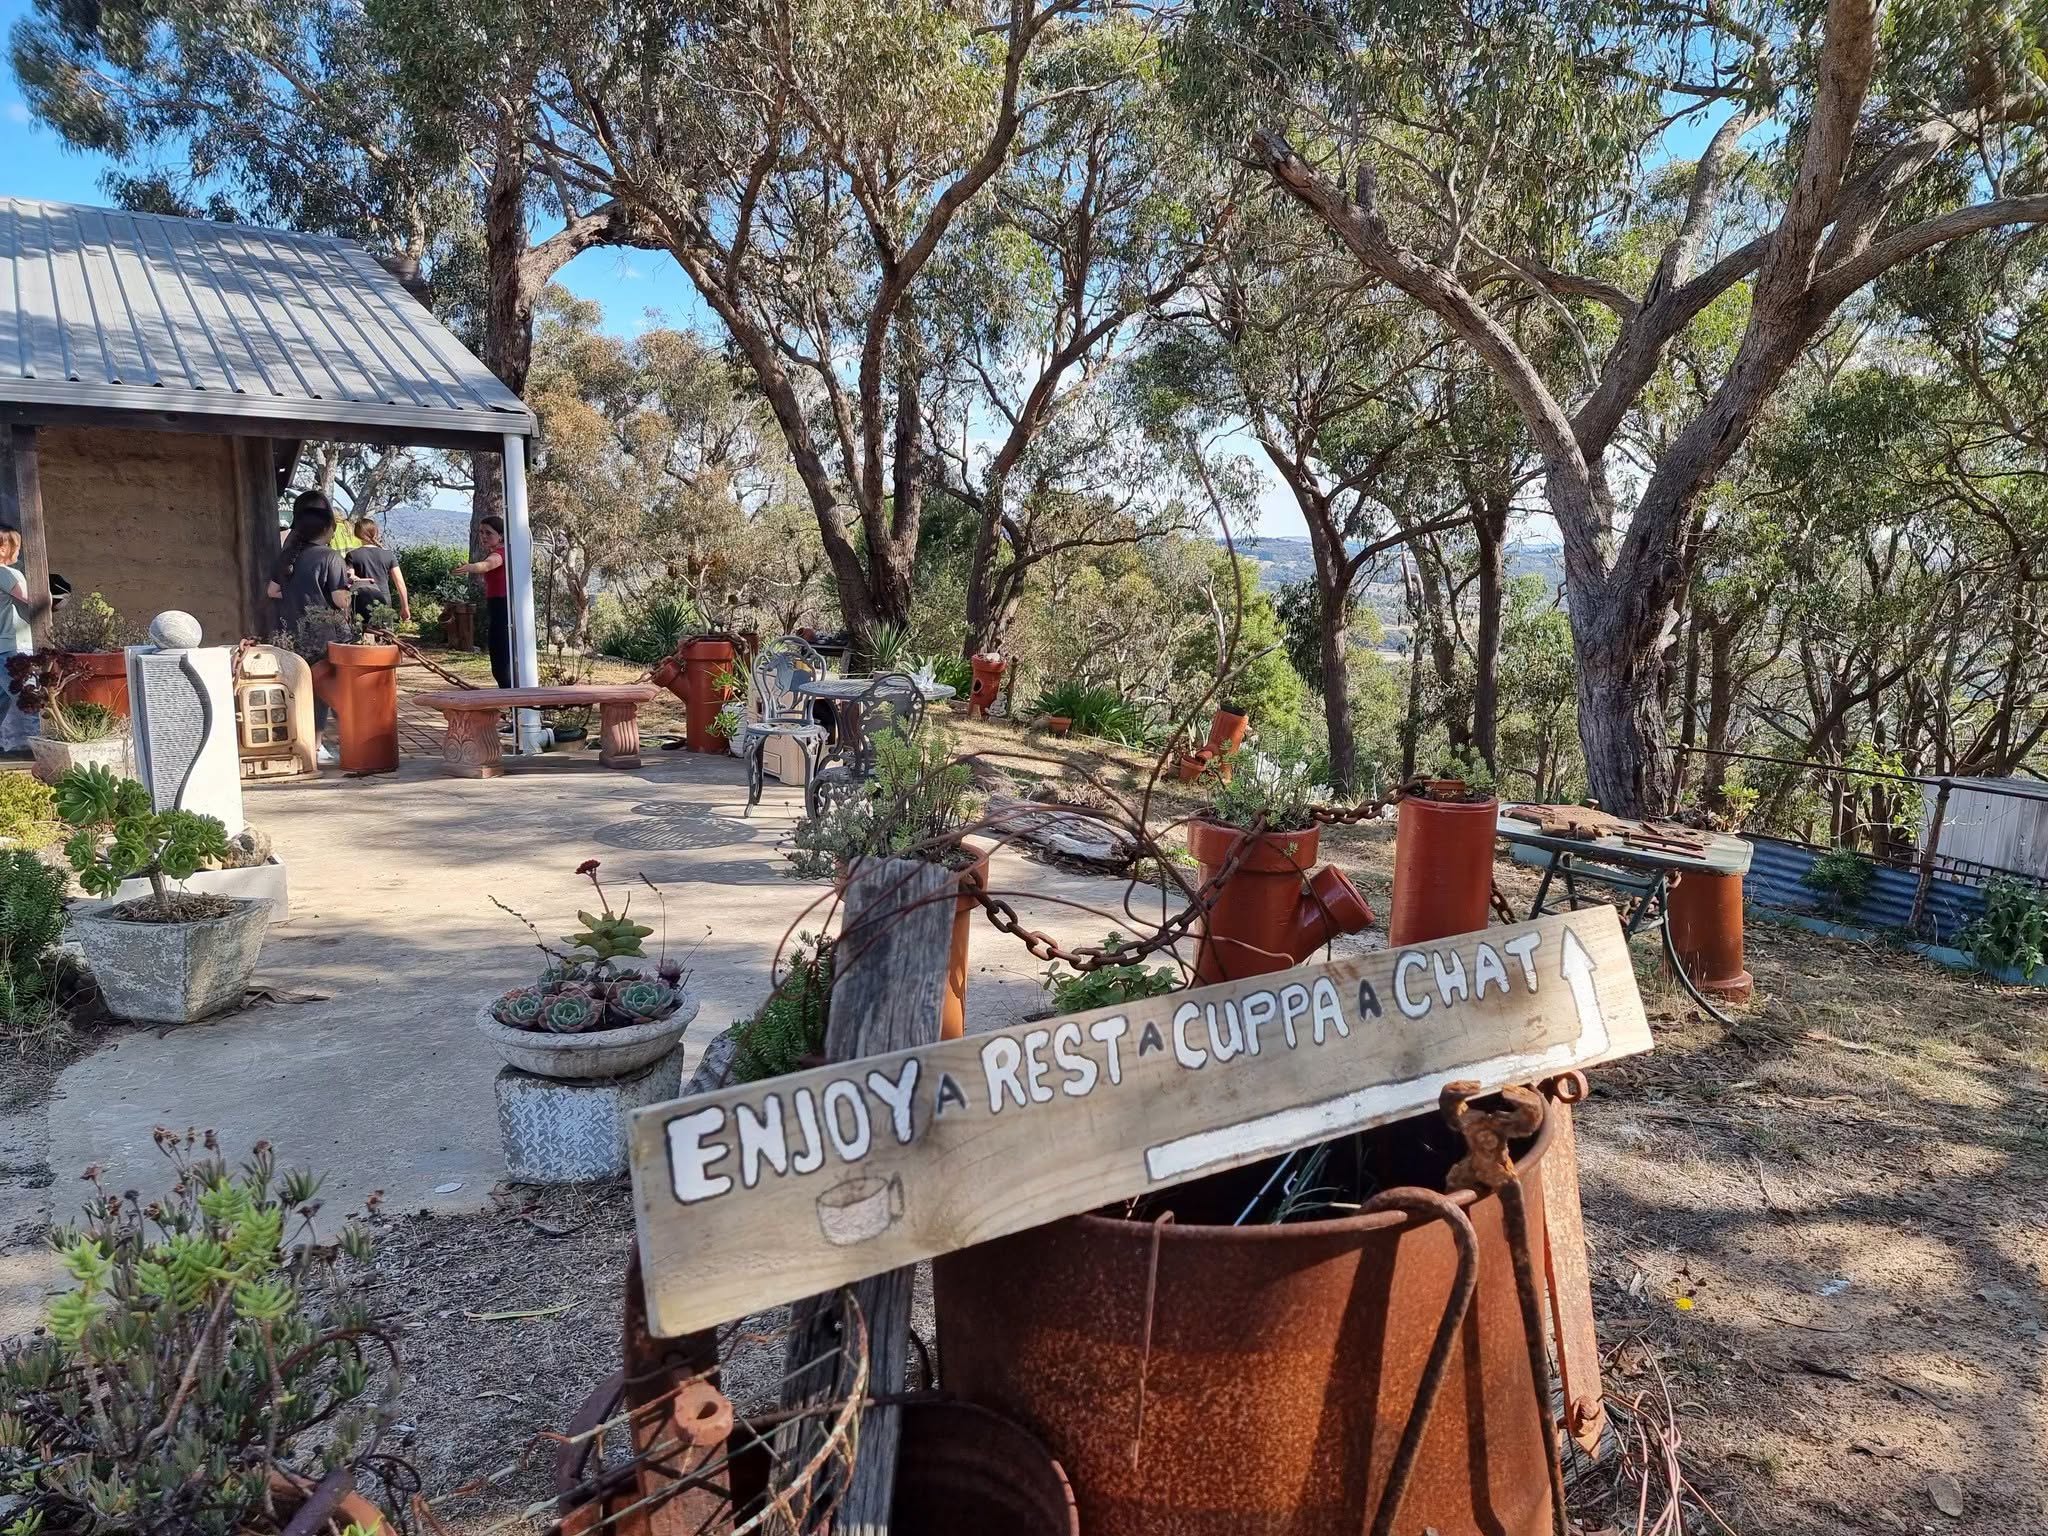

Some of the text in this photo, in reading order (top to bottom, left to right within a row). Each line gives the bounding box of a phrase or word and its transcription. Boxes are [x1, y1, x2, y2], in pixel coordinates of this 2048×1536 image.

[665, 930, 1542, 1205] ENJOY A REST A CUPPA A CHAT
